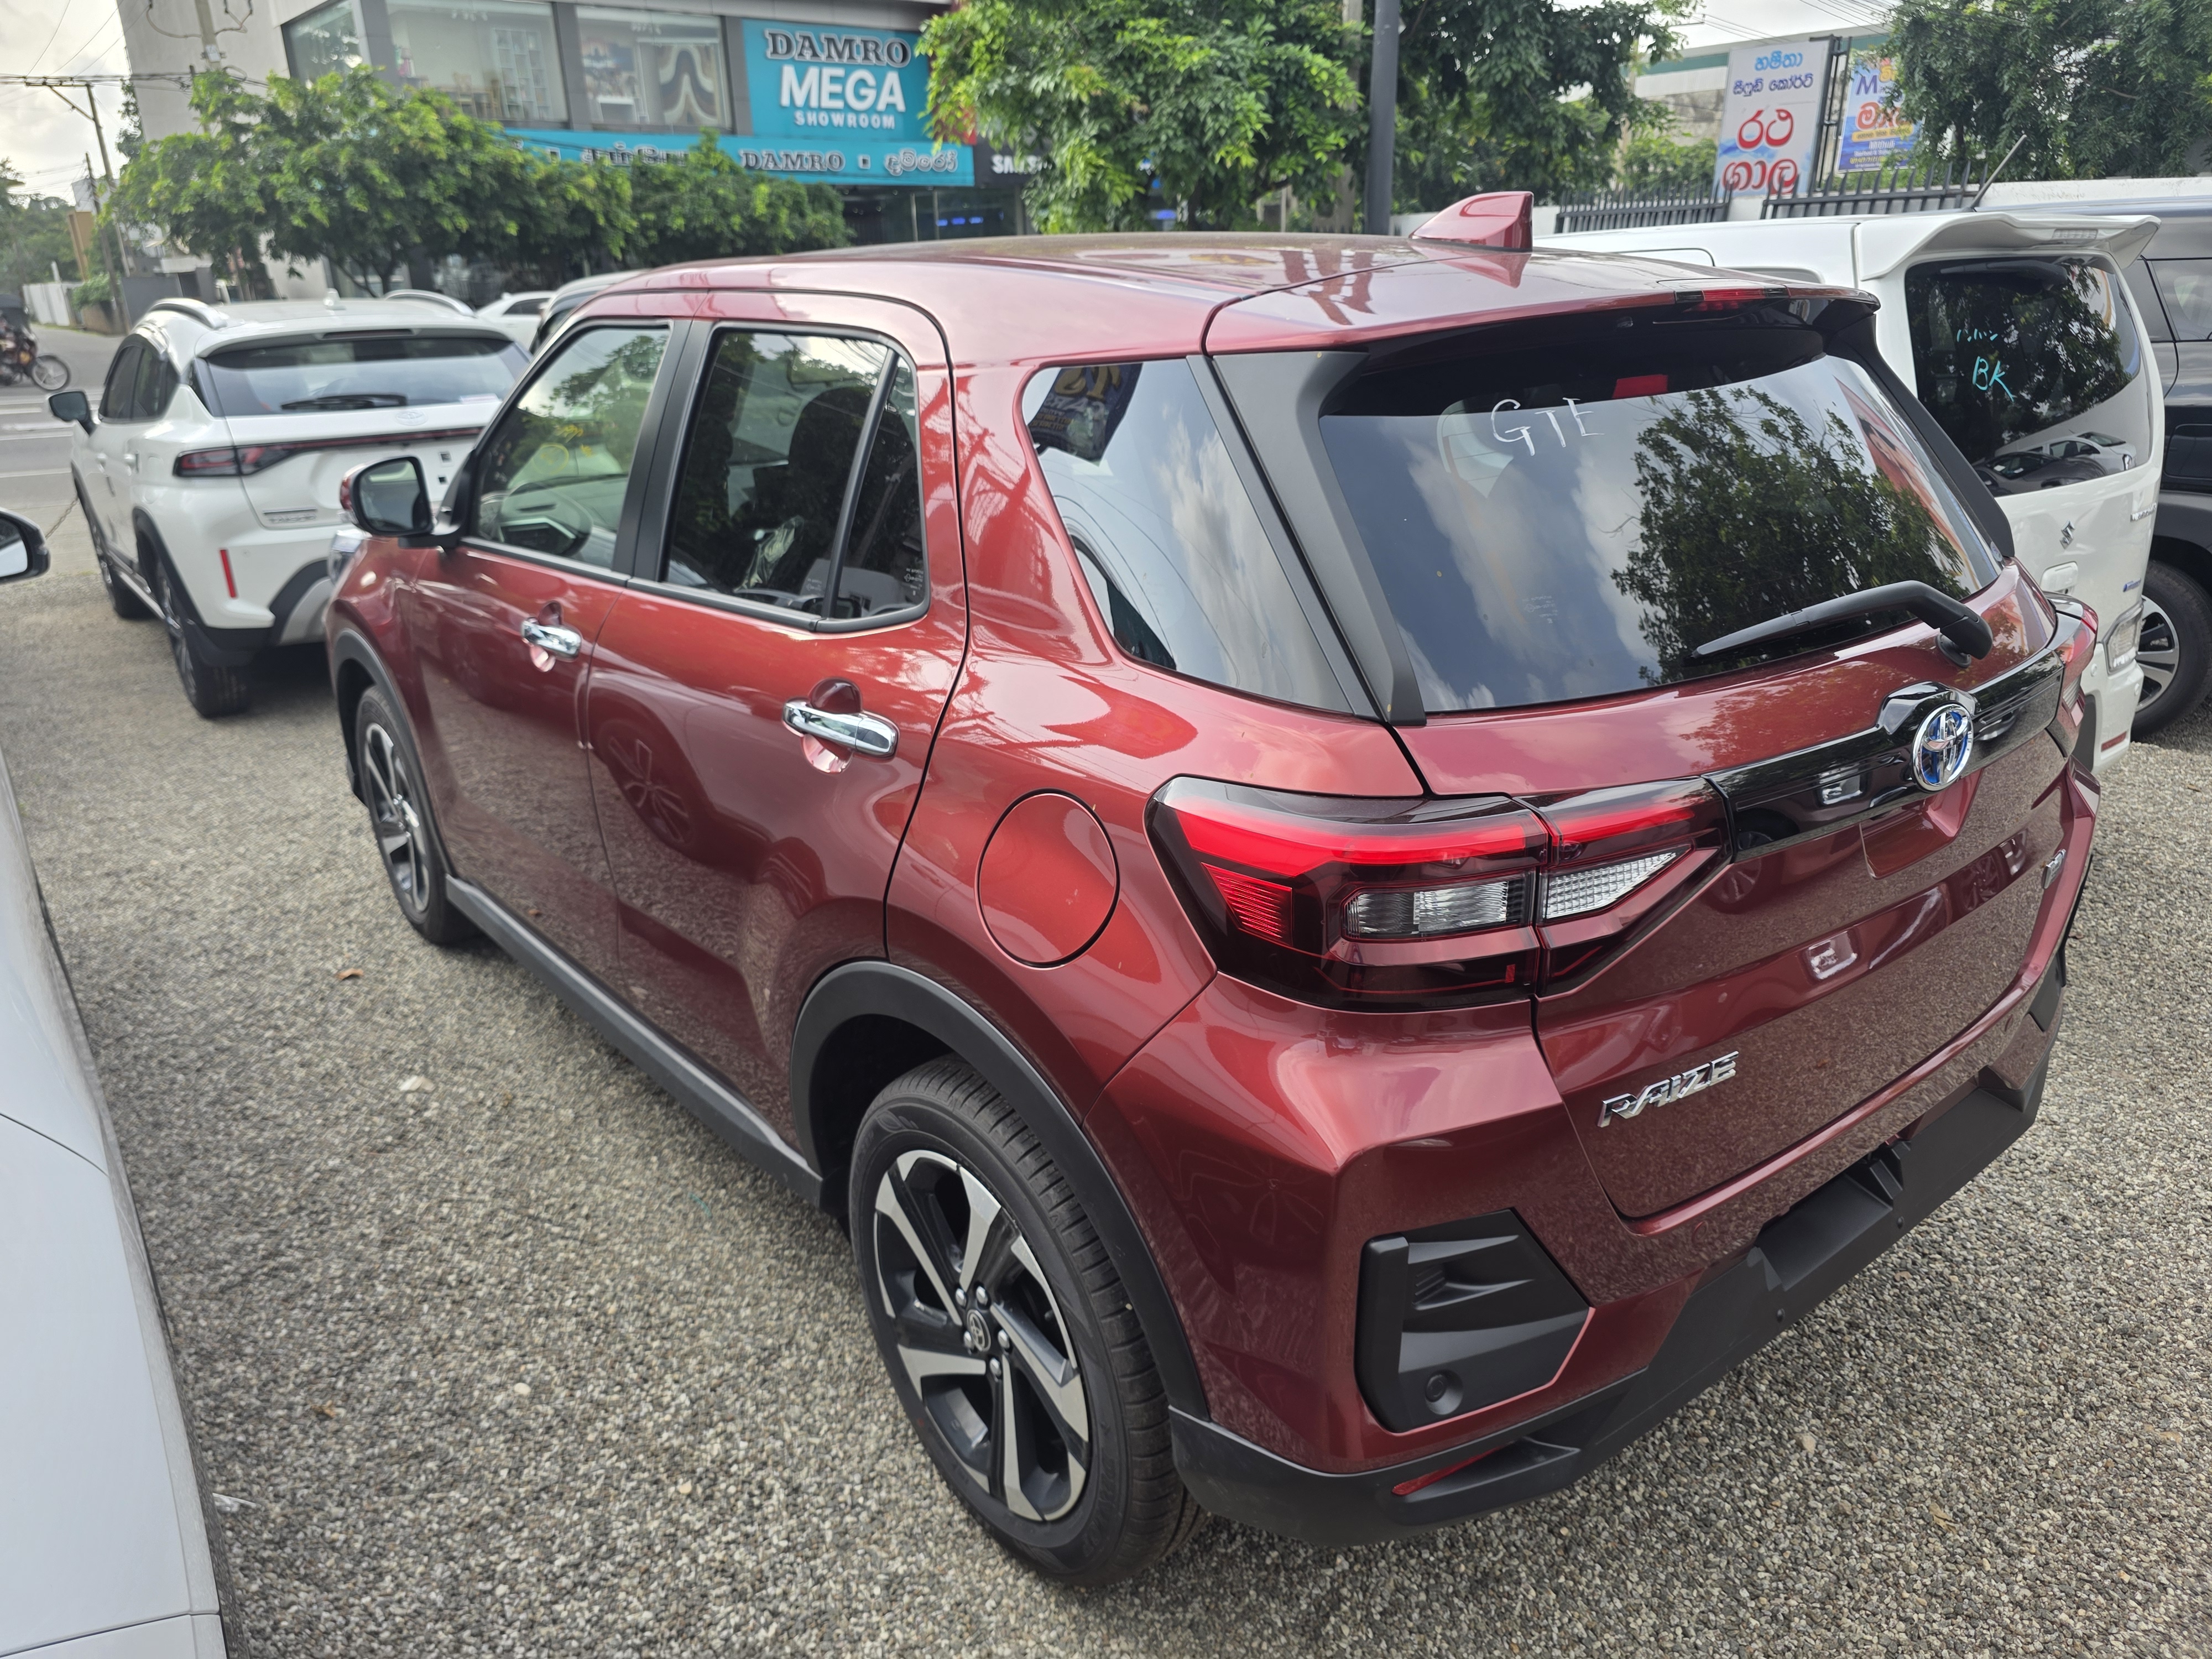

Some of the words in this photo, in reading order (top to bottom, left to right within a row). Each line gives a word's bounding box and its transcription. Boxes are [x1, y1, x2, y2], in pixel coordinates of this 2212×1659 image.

[765, 29, 911, 67] DAMRO
[780, 64, 906, 112] MEGA
[794, 111, 896, 129] SHOWROOM
[739, 149, 846, 172] DAMRO
[1972, 356, 2015, 403] BK
[1597, 1050, 1740, 1129] RAIZE
